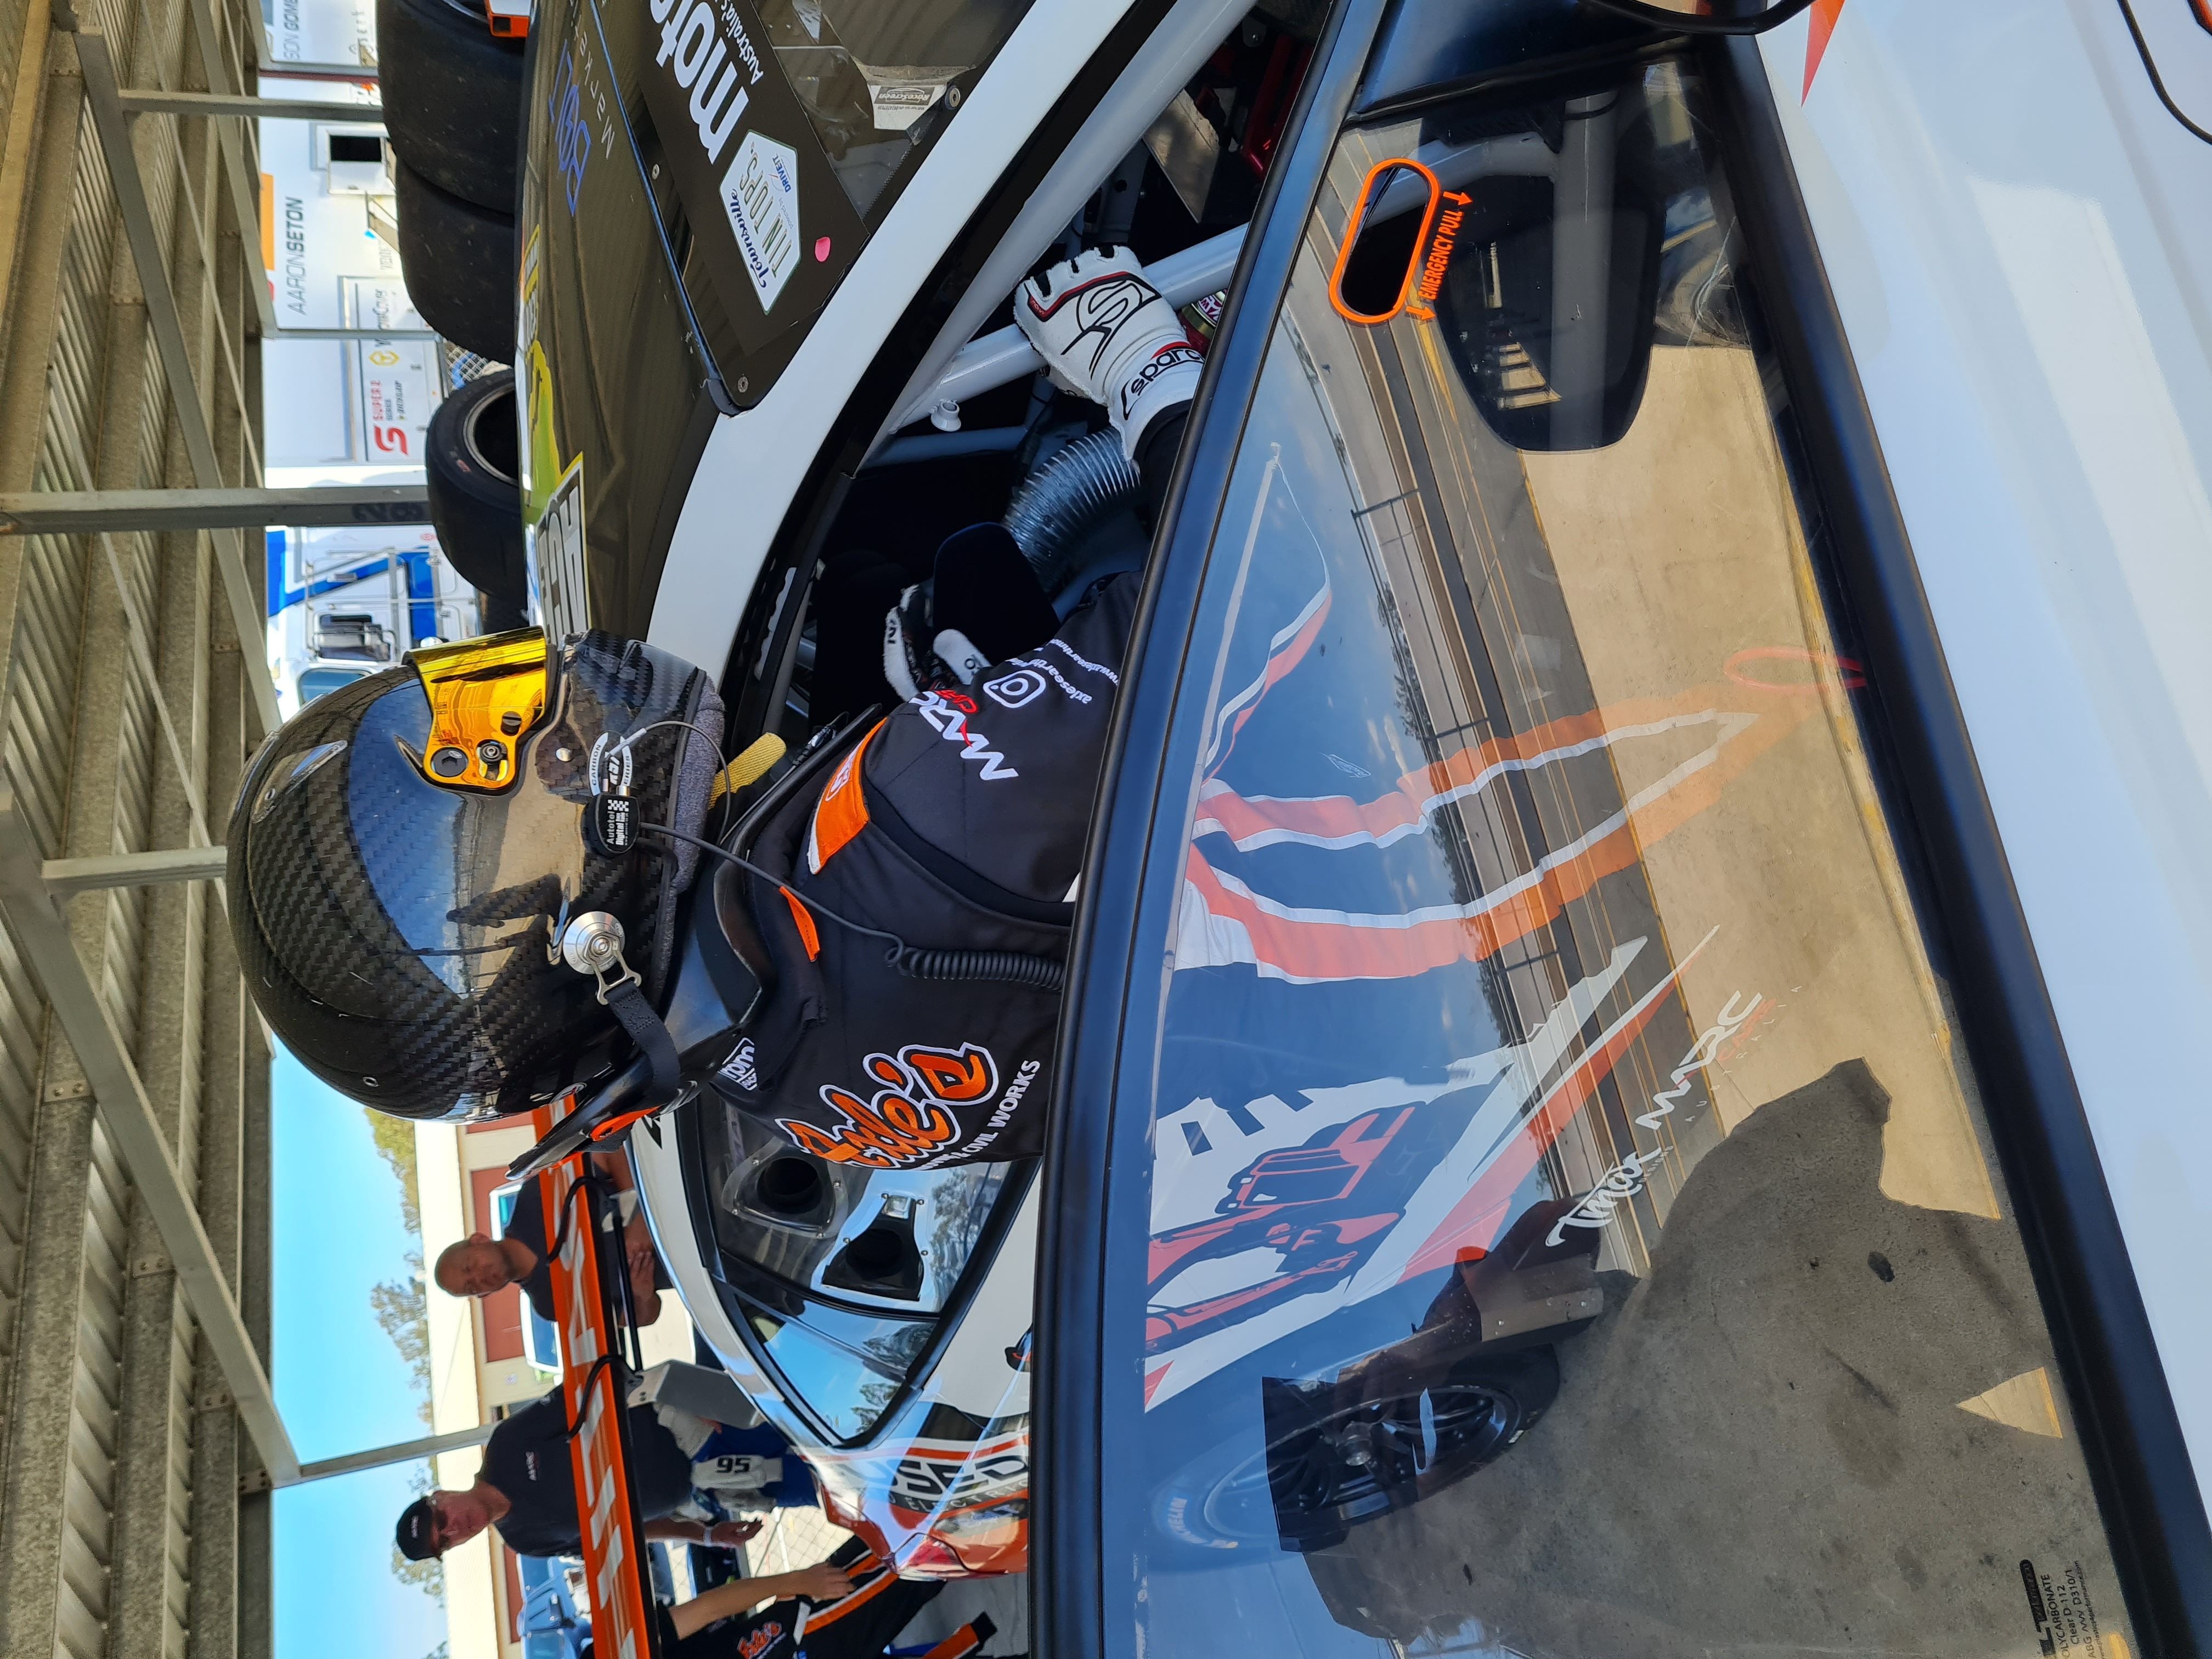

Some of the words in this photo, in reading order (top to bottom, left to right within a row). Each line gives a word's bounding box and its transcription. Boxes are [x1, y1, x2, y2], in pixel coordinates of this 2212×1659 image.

[730, 188, 769, 288] Townsville
[761, 213, 792, 279] TIN
[1418, 234, 1454, 300] EMERGENCY
[1438, 209, 1463, 236] PULL
[1131, 349, 1201, 396] sparc
[591, 744, 602, 786] CARBON
[1685, 985, 1802, 1122] AUSTRALIA
[960, 1132, 999, 1153] CIVIL
[986, 1060, 1041, 1127] WORKS
[2040, 1573, 2070, 1659] OLYCARBONATE
[2057, 1584, 2072, 1616] D-112
[2064, 1568, 2082, 1605] D310/1
[2067, 1618, 2079, 1645] Clear
